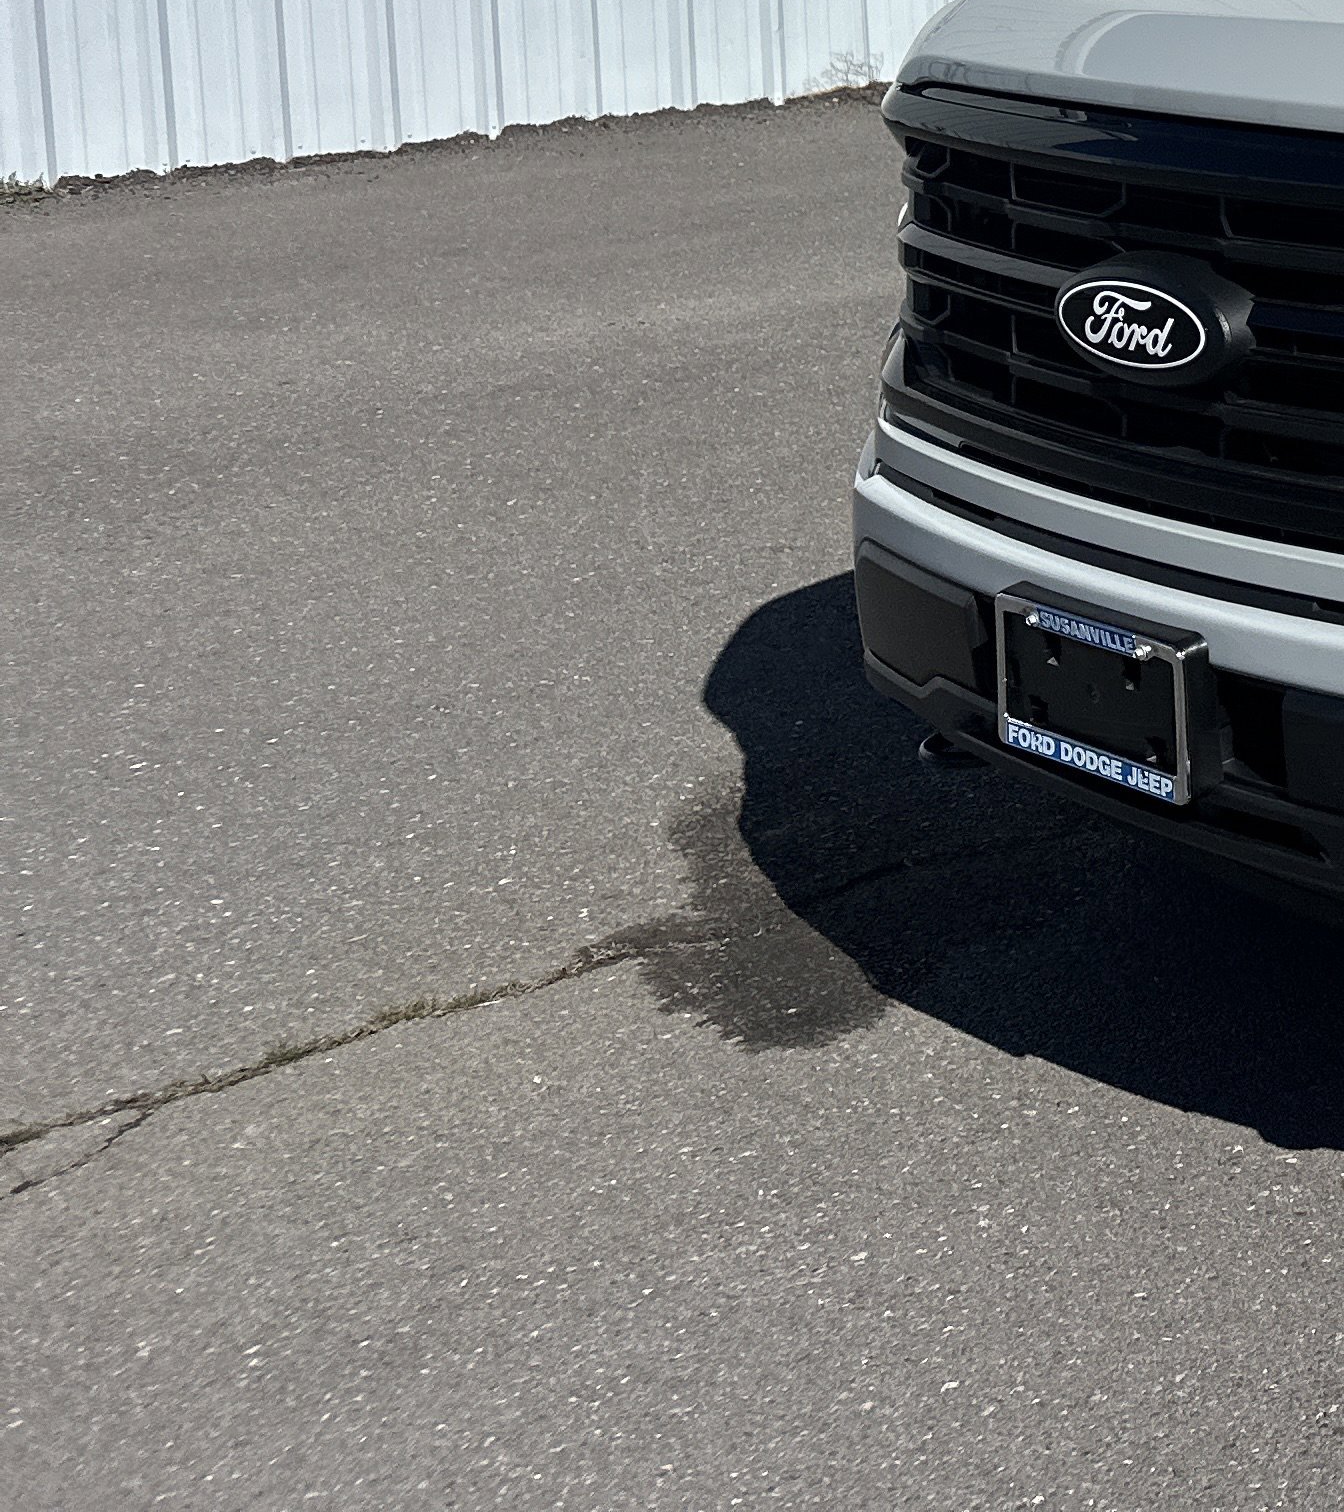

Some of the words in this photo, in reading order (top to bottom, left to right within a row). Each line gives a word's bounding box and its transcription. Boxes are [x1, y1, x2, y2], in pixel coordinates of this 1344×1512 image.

[1085, 290, 1175, 358] Ford
[1039, 610, 1136, 653] SUSANVILLE
[1007, 723, 1055, 755] FORD
[1060, 741, 1122, 781] DODGE
[1127, 766, 1173, 797] JEEP
